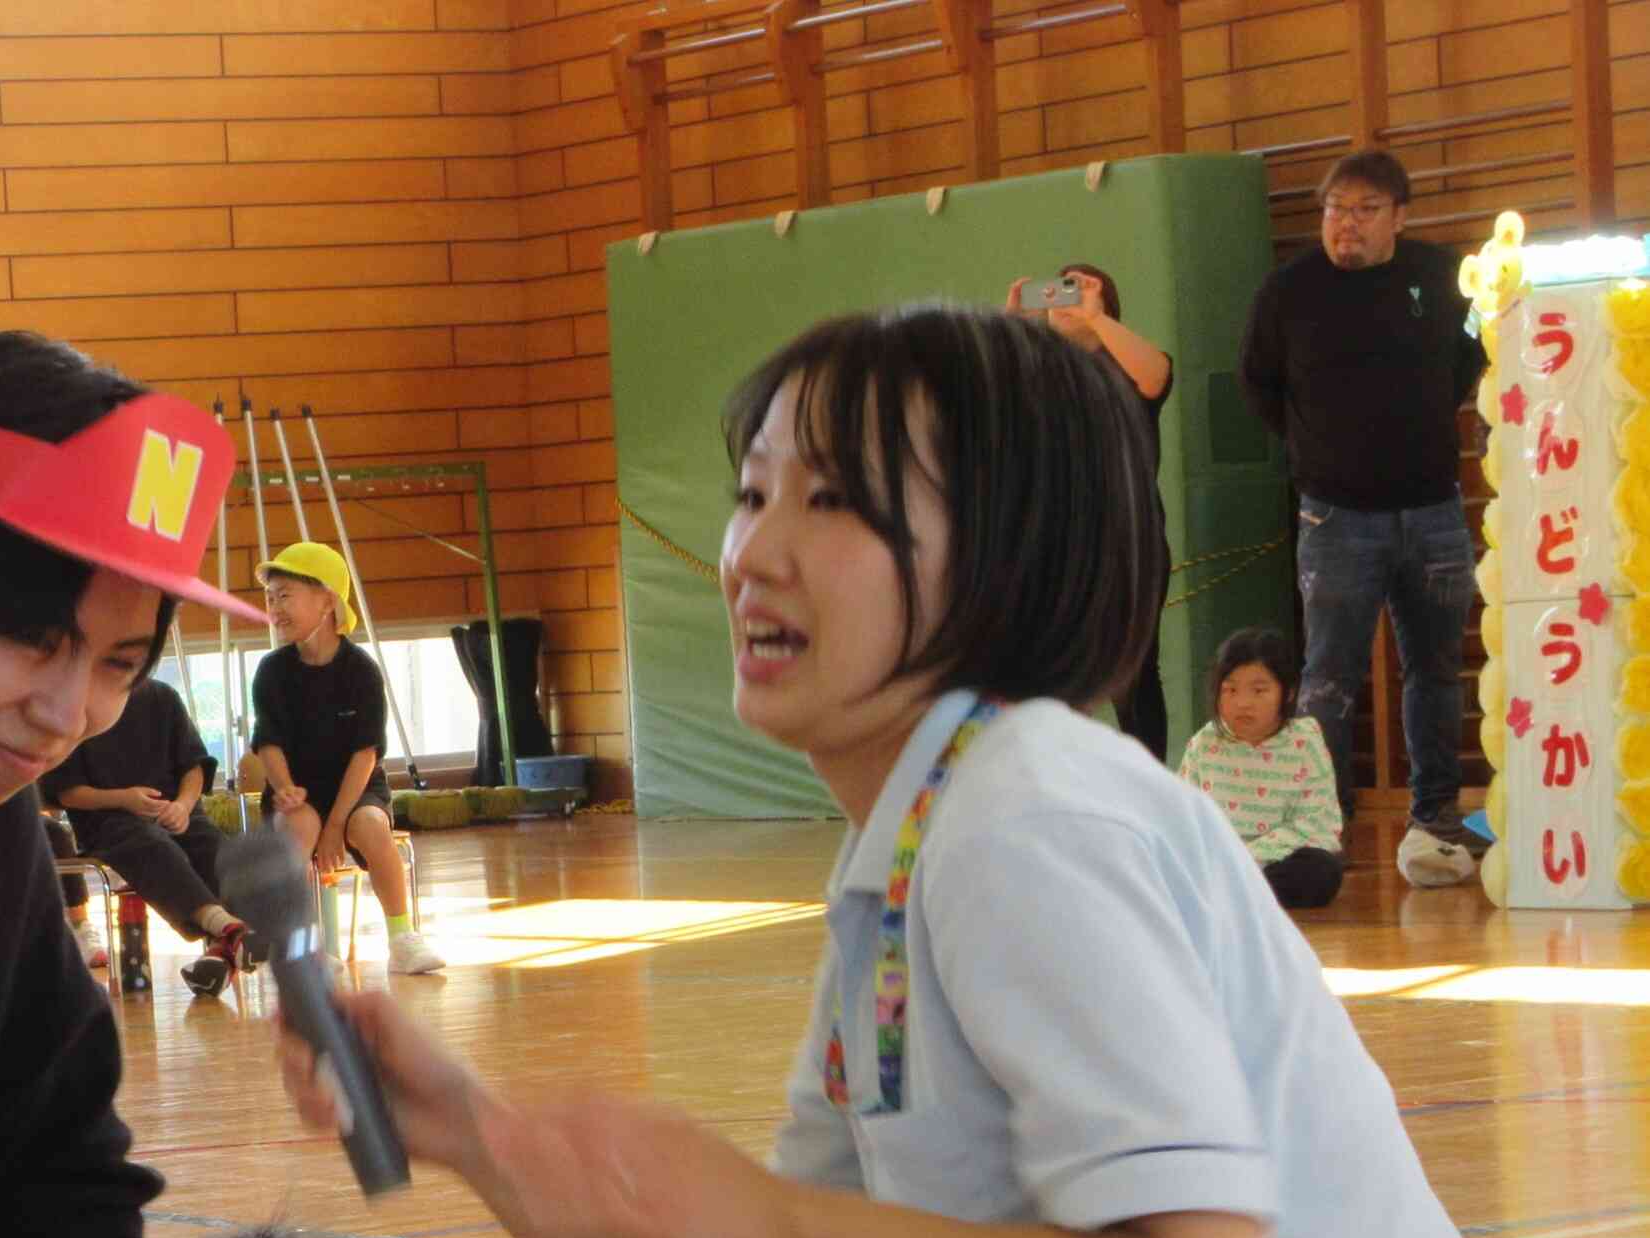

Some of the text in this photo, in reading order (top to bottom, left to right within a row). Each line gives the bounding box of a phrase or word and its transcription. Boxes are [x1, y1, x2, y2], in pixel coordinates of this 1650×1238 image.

[126, 428, 204, 543] N
[1532, 311, 1591, 886] うんどうかい
